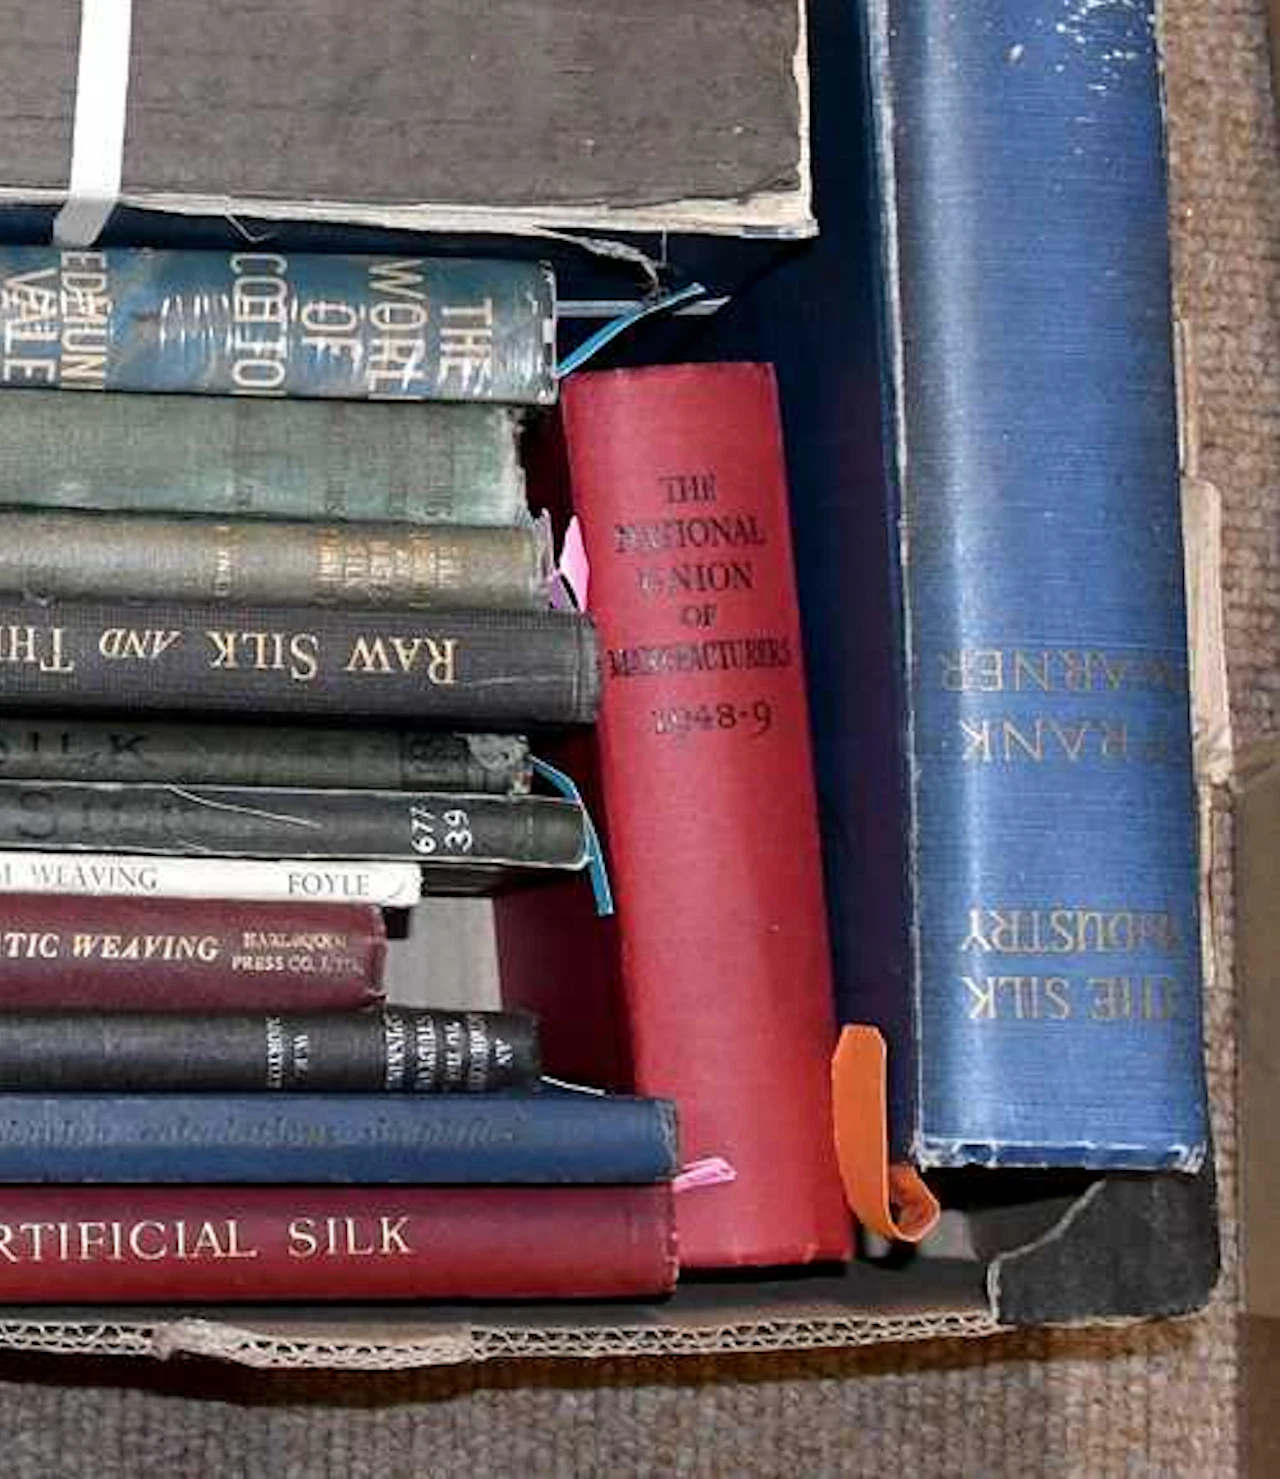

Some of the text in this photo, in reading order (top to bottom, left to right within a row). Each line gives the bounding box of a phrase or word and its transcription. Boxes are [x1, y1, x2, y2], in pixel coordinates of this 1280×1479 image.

[0, 266, 59, 383] VALE
[229, 252, 290, 397] COTTO
[300, 300, 358, 372] OF
[437, 299, 493, 396] THE
[657, 473, 718, 505] THE
[614, 515, 767, 553] NATIONAL
[681, 604, 718, 630] OF
[98, 624, 182, 663] AND
[29, 863, 158, 890] WEAVING
[288, 870, 370, 897] FOYLE
[72, 933, 223, 963] WEAVING
[960, 908, 1174, 954] INDUSTRY
[960, 976, 1174, 1021] THE SILK
[286, 1217, 413, 1260] SILK
